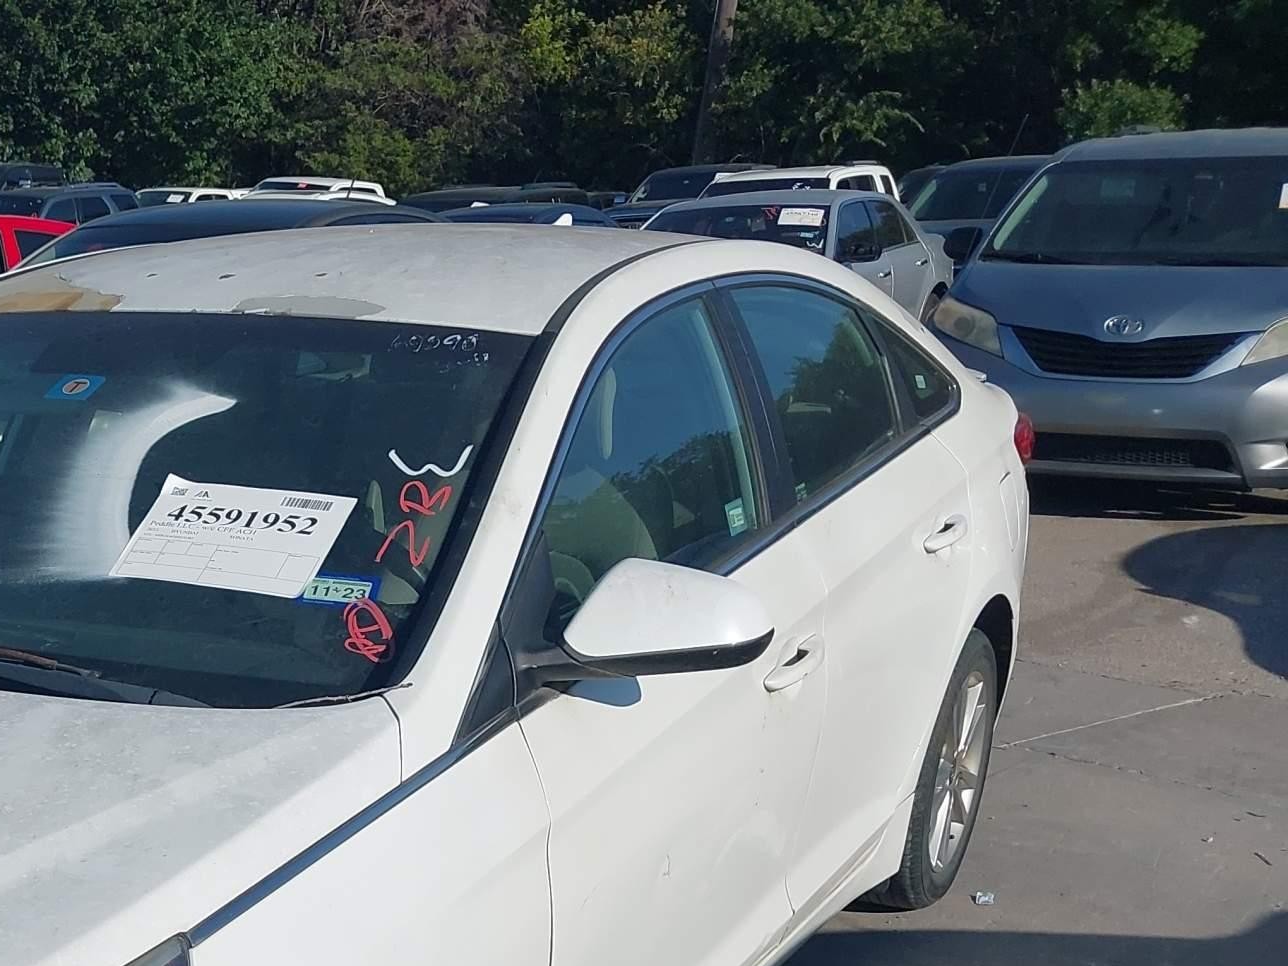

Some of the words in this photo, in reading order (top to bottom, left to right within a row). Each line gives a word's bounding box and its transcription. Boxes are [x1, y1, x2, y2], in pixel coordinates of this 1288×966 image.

[167, 503, 318, 536] 45591952
[312, 585, 331, 597] 11
[342, 587, 367, 600] 23
